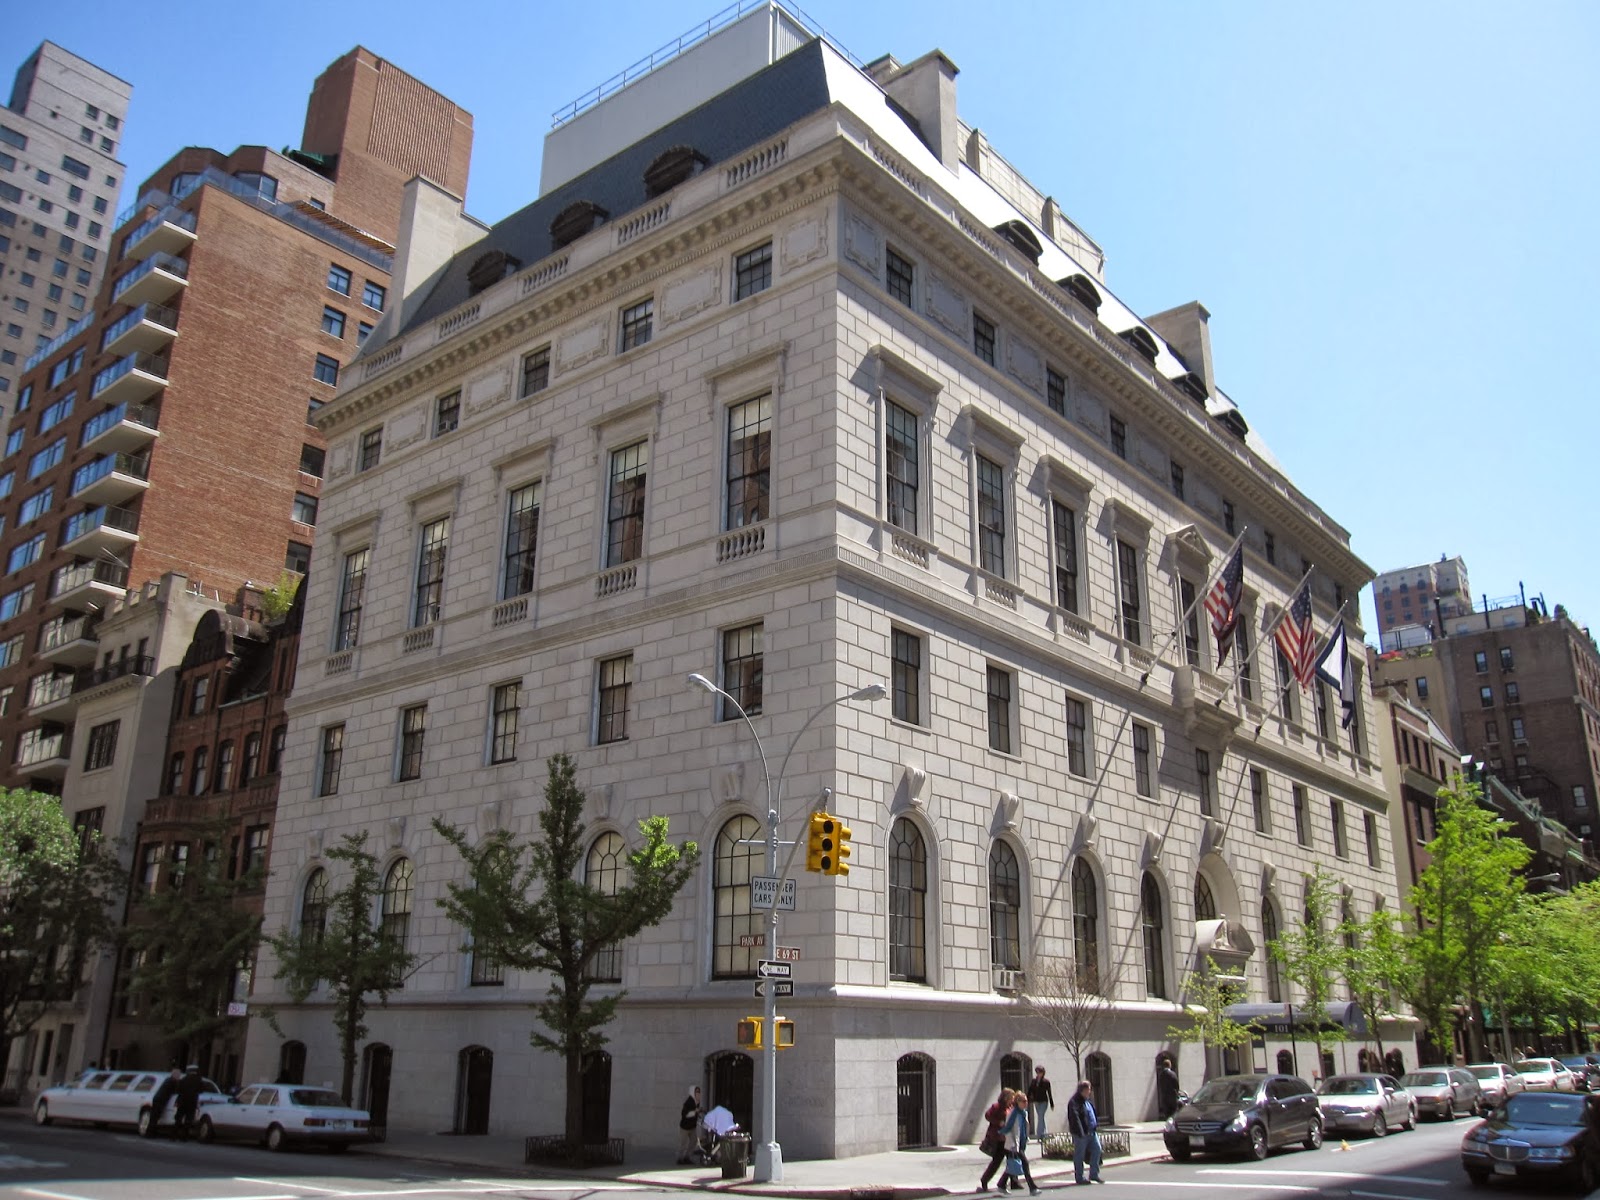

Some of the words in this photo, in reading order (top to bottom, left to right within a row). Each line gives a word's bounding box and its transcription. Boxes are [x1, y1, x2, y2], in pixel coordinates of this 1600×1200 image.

[754, 881, 794, 893] PASSENER
[754, 893, 772, 904] CARS
[777, 895, 793, 905] NLY
[741, 936, 755, 946] PARK
[756, 936, 764, 946] AV
[776, 949, 780, 959] E
[782, 949, 790, 959] 69
[792, 950, 799, 960] ST
[762, 965, 773, 973] ONE
[775, 985, 789, 993] WAY
[1274, 1024, 1288, 1033] 101
